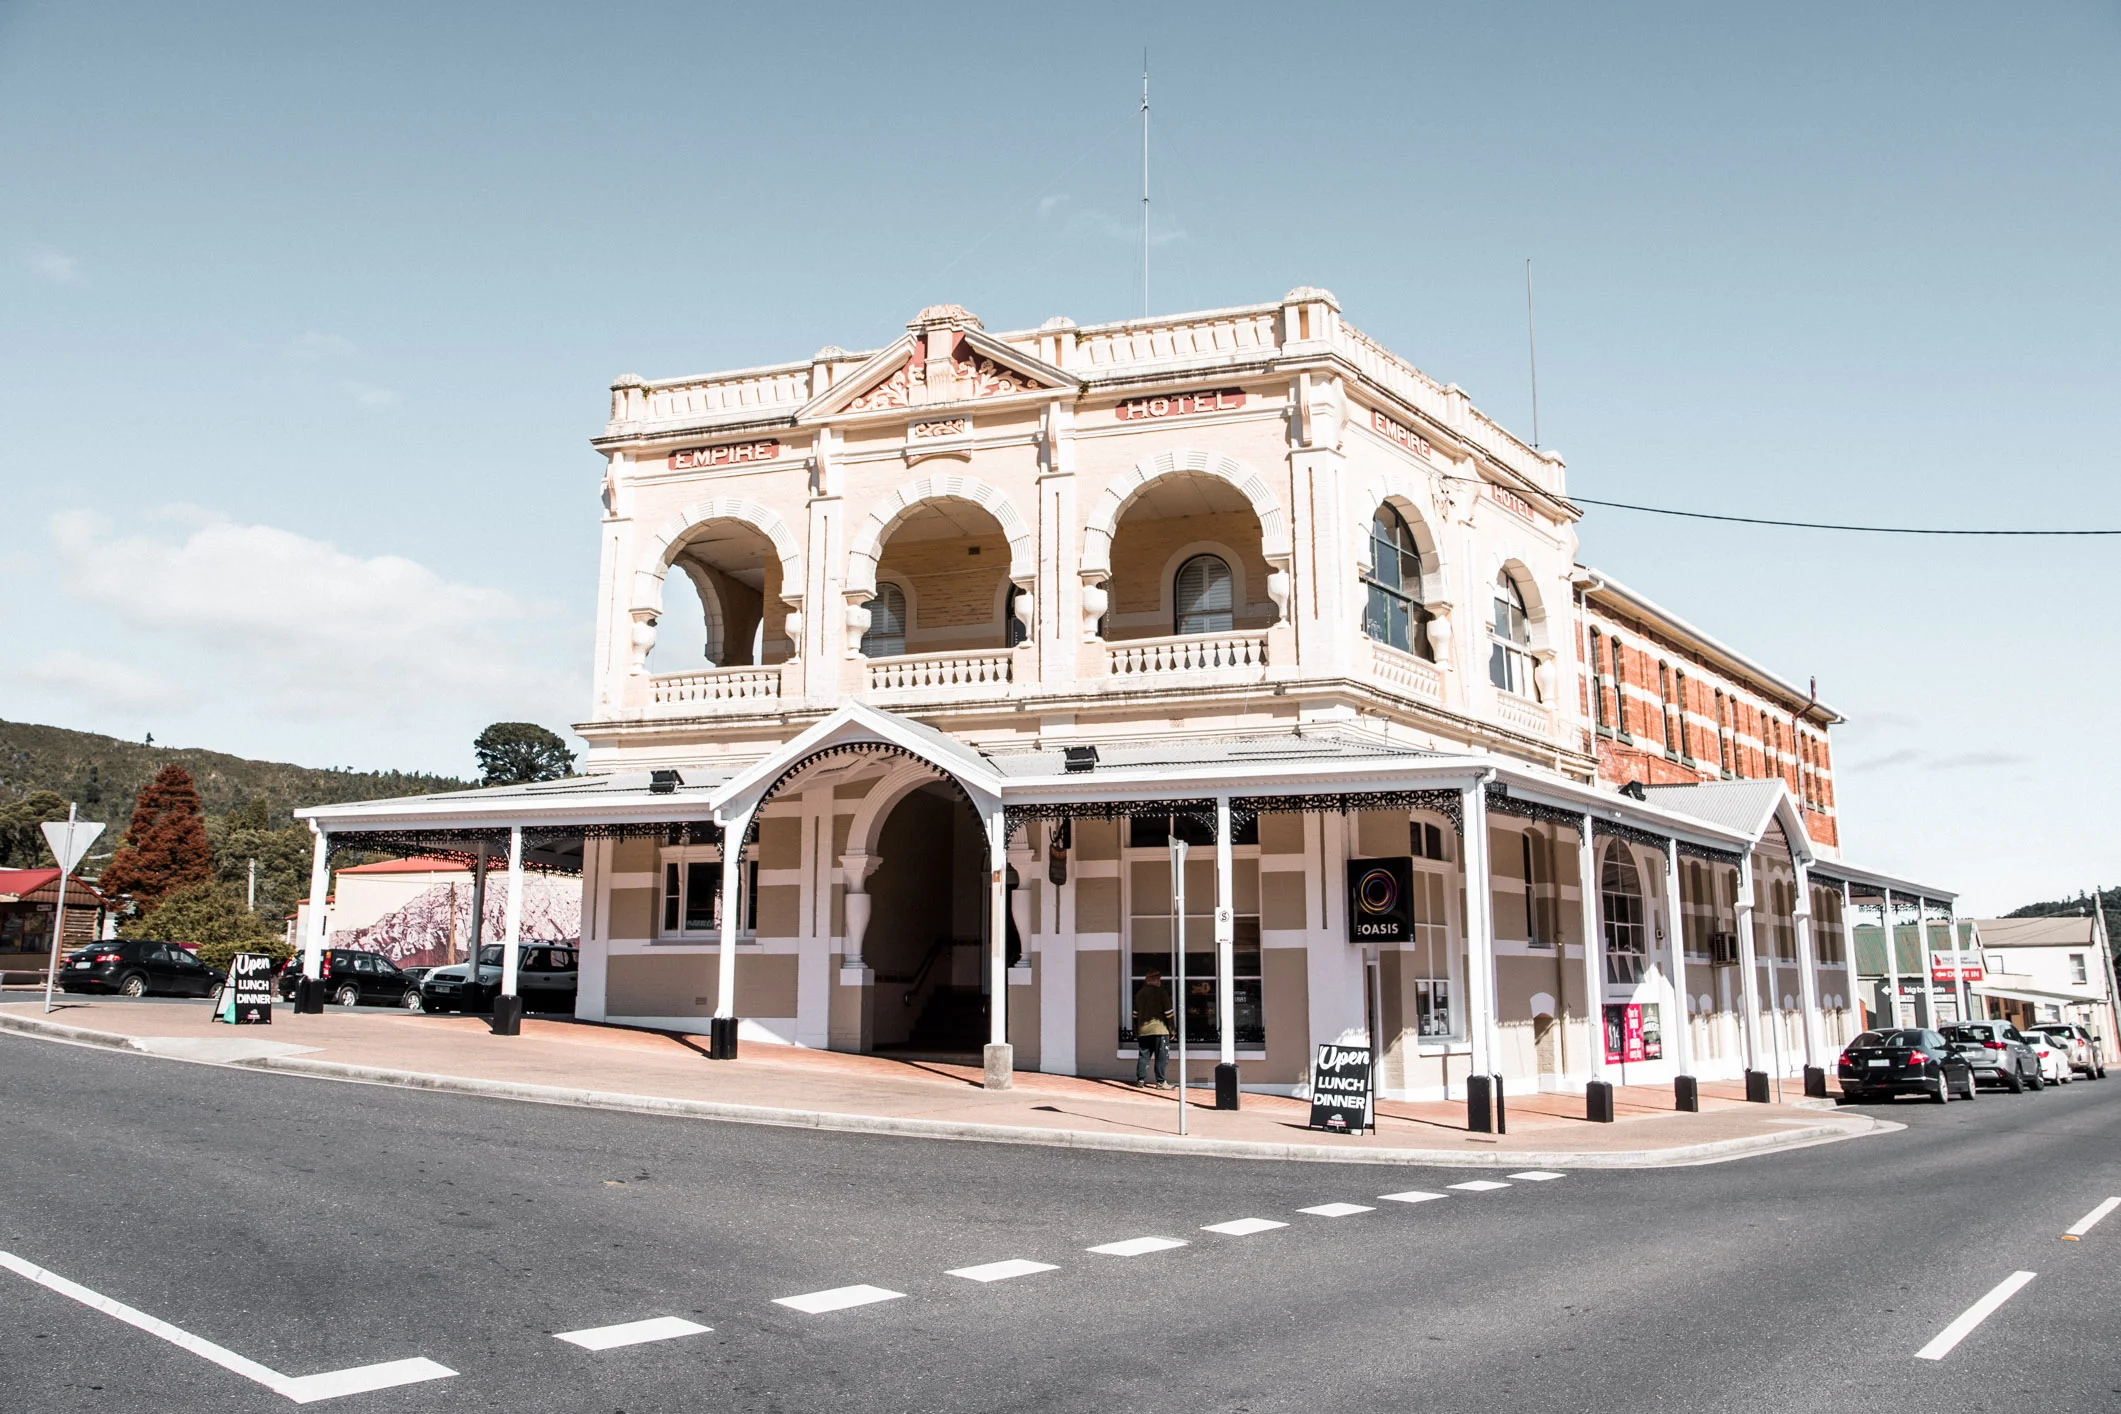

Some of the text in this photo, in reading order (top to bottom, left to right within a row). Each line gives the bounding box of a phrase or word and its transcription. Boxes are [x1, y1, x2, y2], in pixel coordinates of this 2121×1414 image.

[1126, 390, 1237, 420] HOTEL
[1375, 411, 1430, 459] EMPIRE
[675, 441, 773, 469] EMPIRE
[1494, 485, 1533, 523] HOTEL
[1361, 923, 1399, 935] OASIS
[236, 954, 270, 976] Open
[1947, 970, 1980, 978] DVE IN
[238, 979, 270, 990] LUNCH
[1903, 985, 1917, 995] big
[1917, 985, 1946, 994] baain
[236, 993, 271, 1004] DINNER
[1318, 1046, 1370, 1073] Open
[1317, 1076, 1365, 1092] LUNCH
[1313, 1093, 1366, 1110] DINNER
